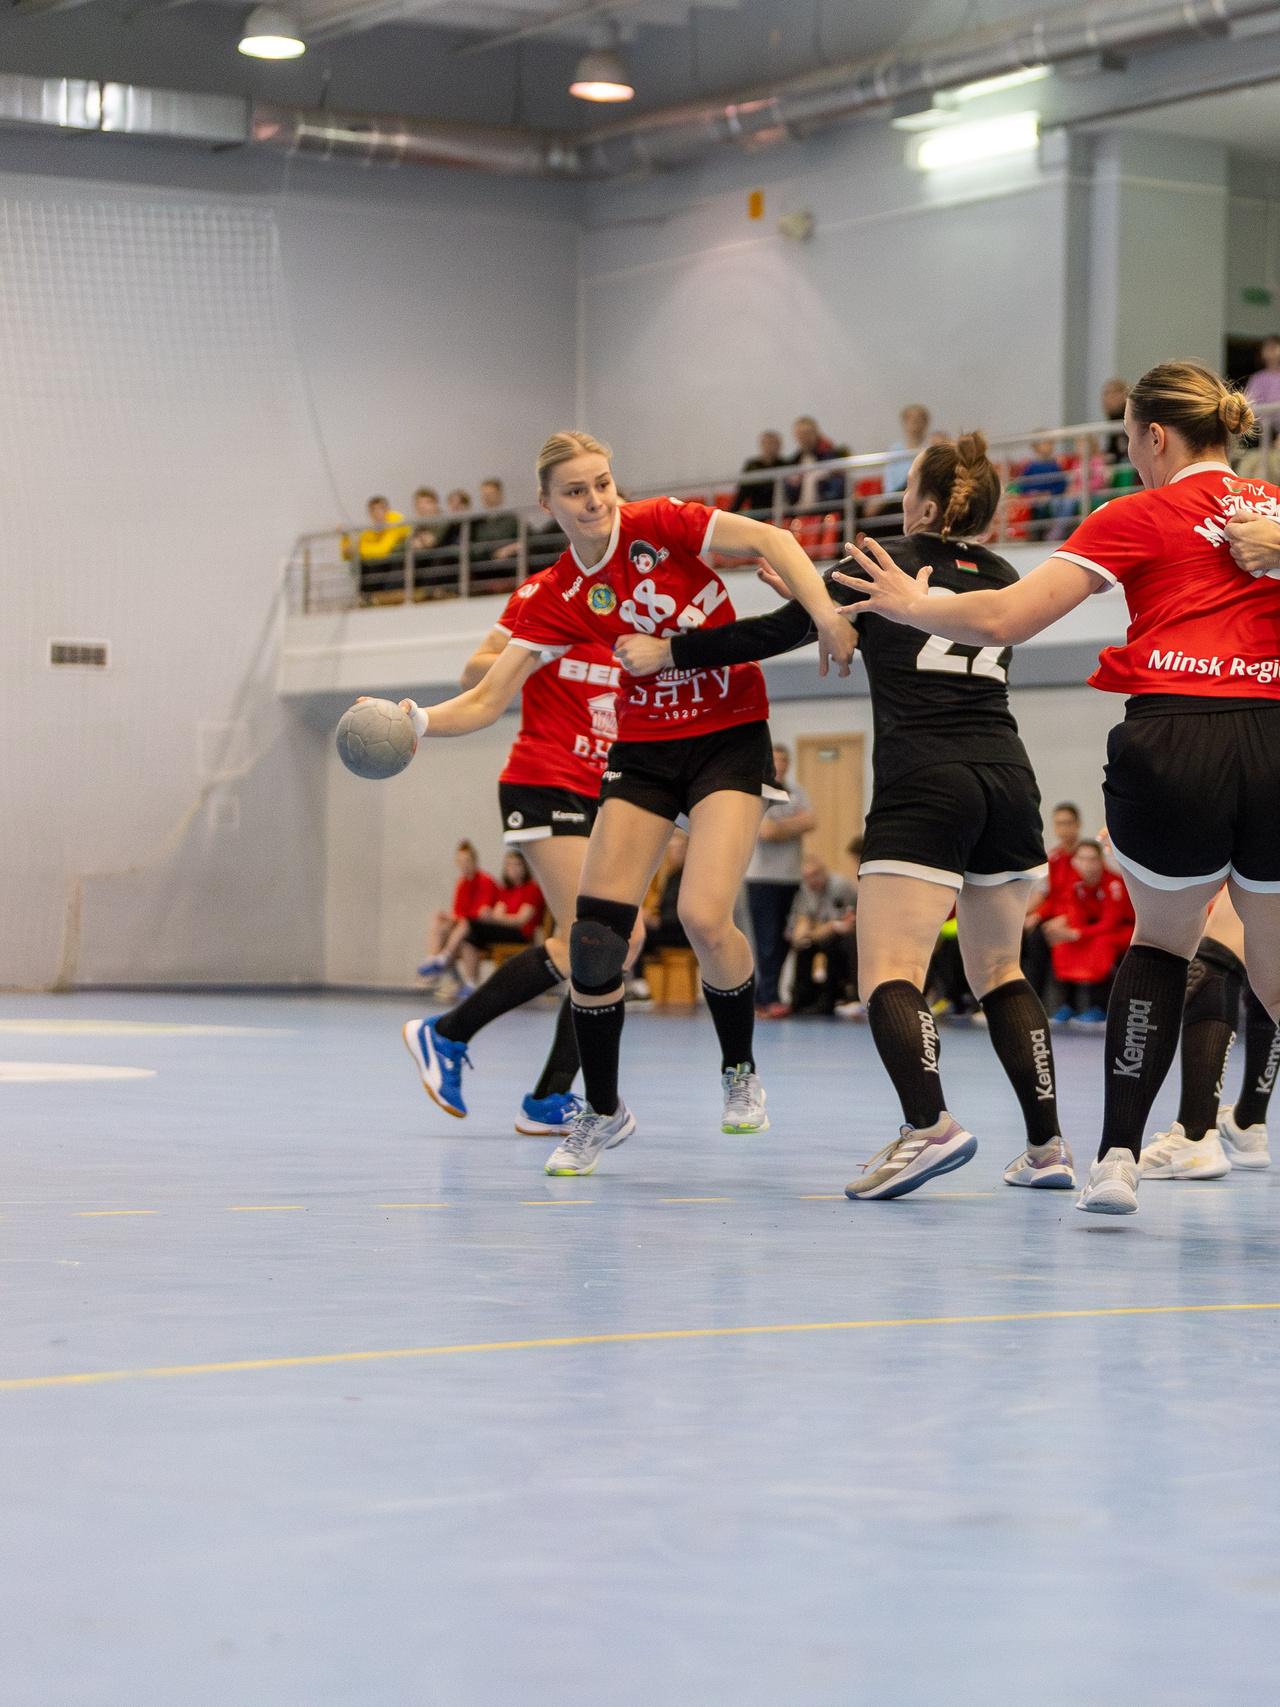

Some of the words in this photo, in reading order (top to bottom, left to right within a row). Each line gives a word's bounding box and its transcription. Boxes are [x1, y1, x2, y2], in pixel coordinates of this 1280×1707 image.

[618, 578, 677, 635] 88
[1148, 649, 1225, 677] Minsk
[917, 1010, 940, 1074] Kempa
[1030, 1027, 1056, 1101] Kempa
[1112, 998, 1158, 1079] Kempa
[1213, 1030, 1238, 1100] Kempa
